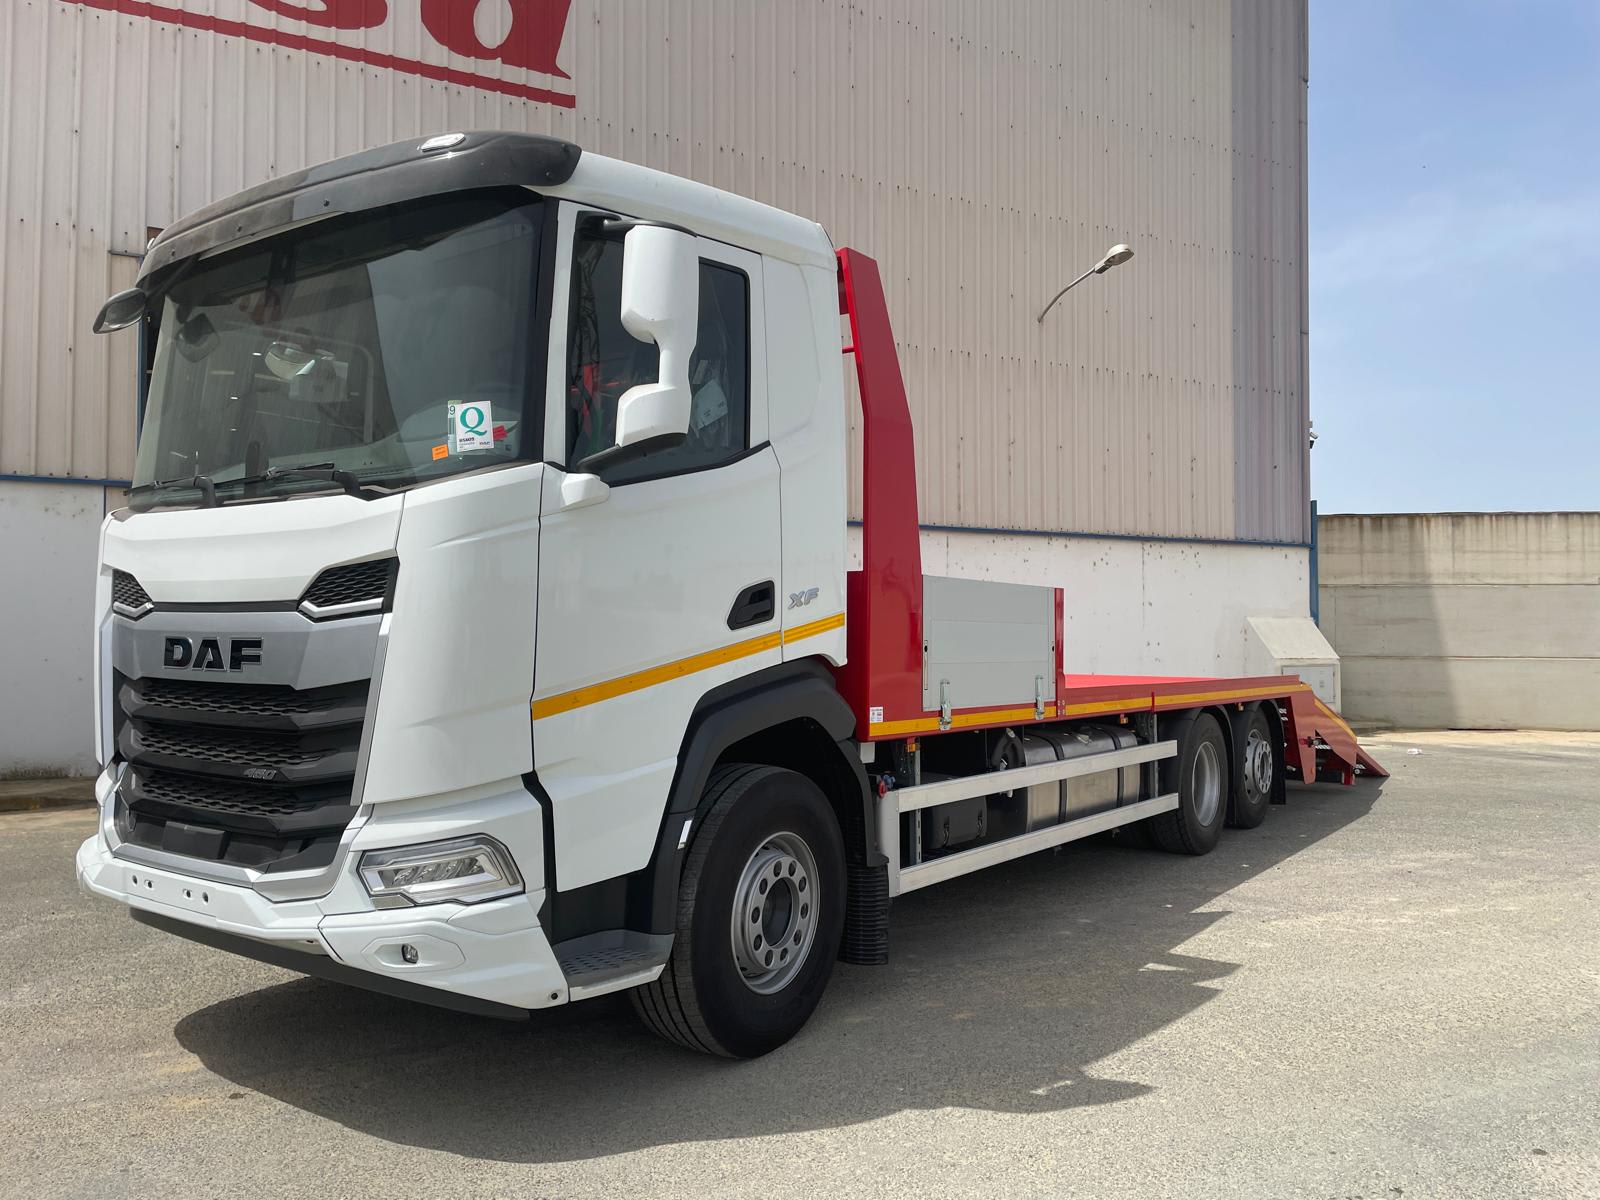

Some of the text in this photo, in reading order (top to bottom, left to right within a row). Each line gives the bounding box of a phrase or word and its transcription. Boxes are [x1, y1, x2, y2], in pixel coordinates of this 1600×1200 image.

[460, 406, 487, 436] Q
[788, 587, 820, 610] XF
[162, 636, 264, 672] DAF
